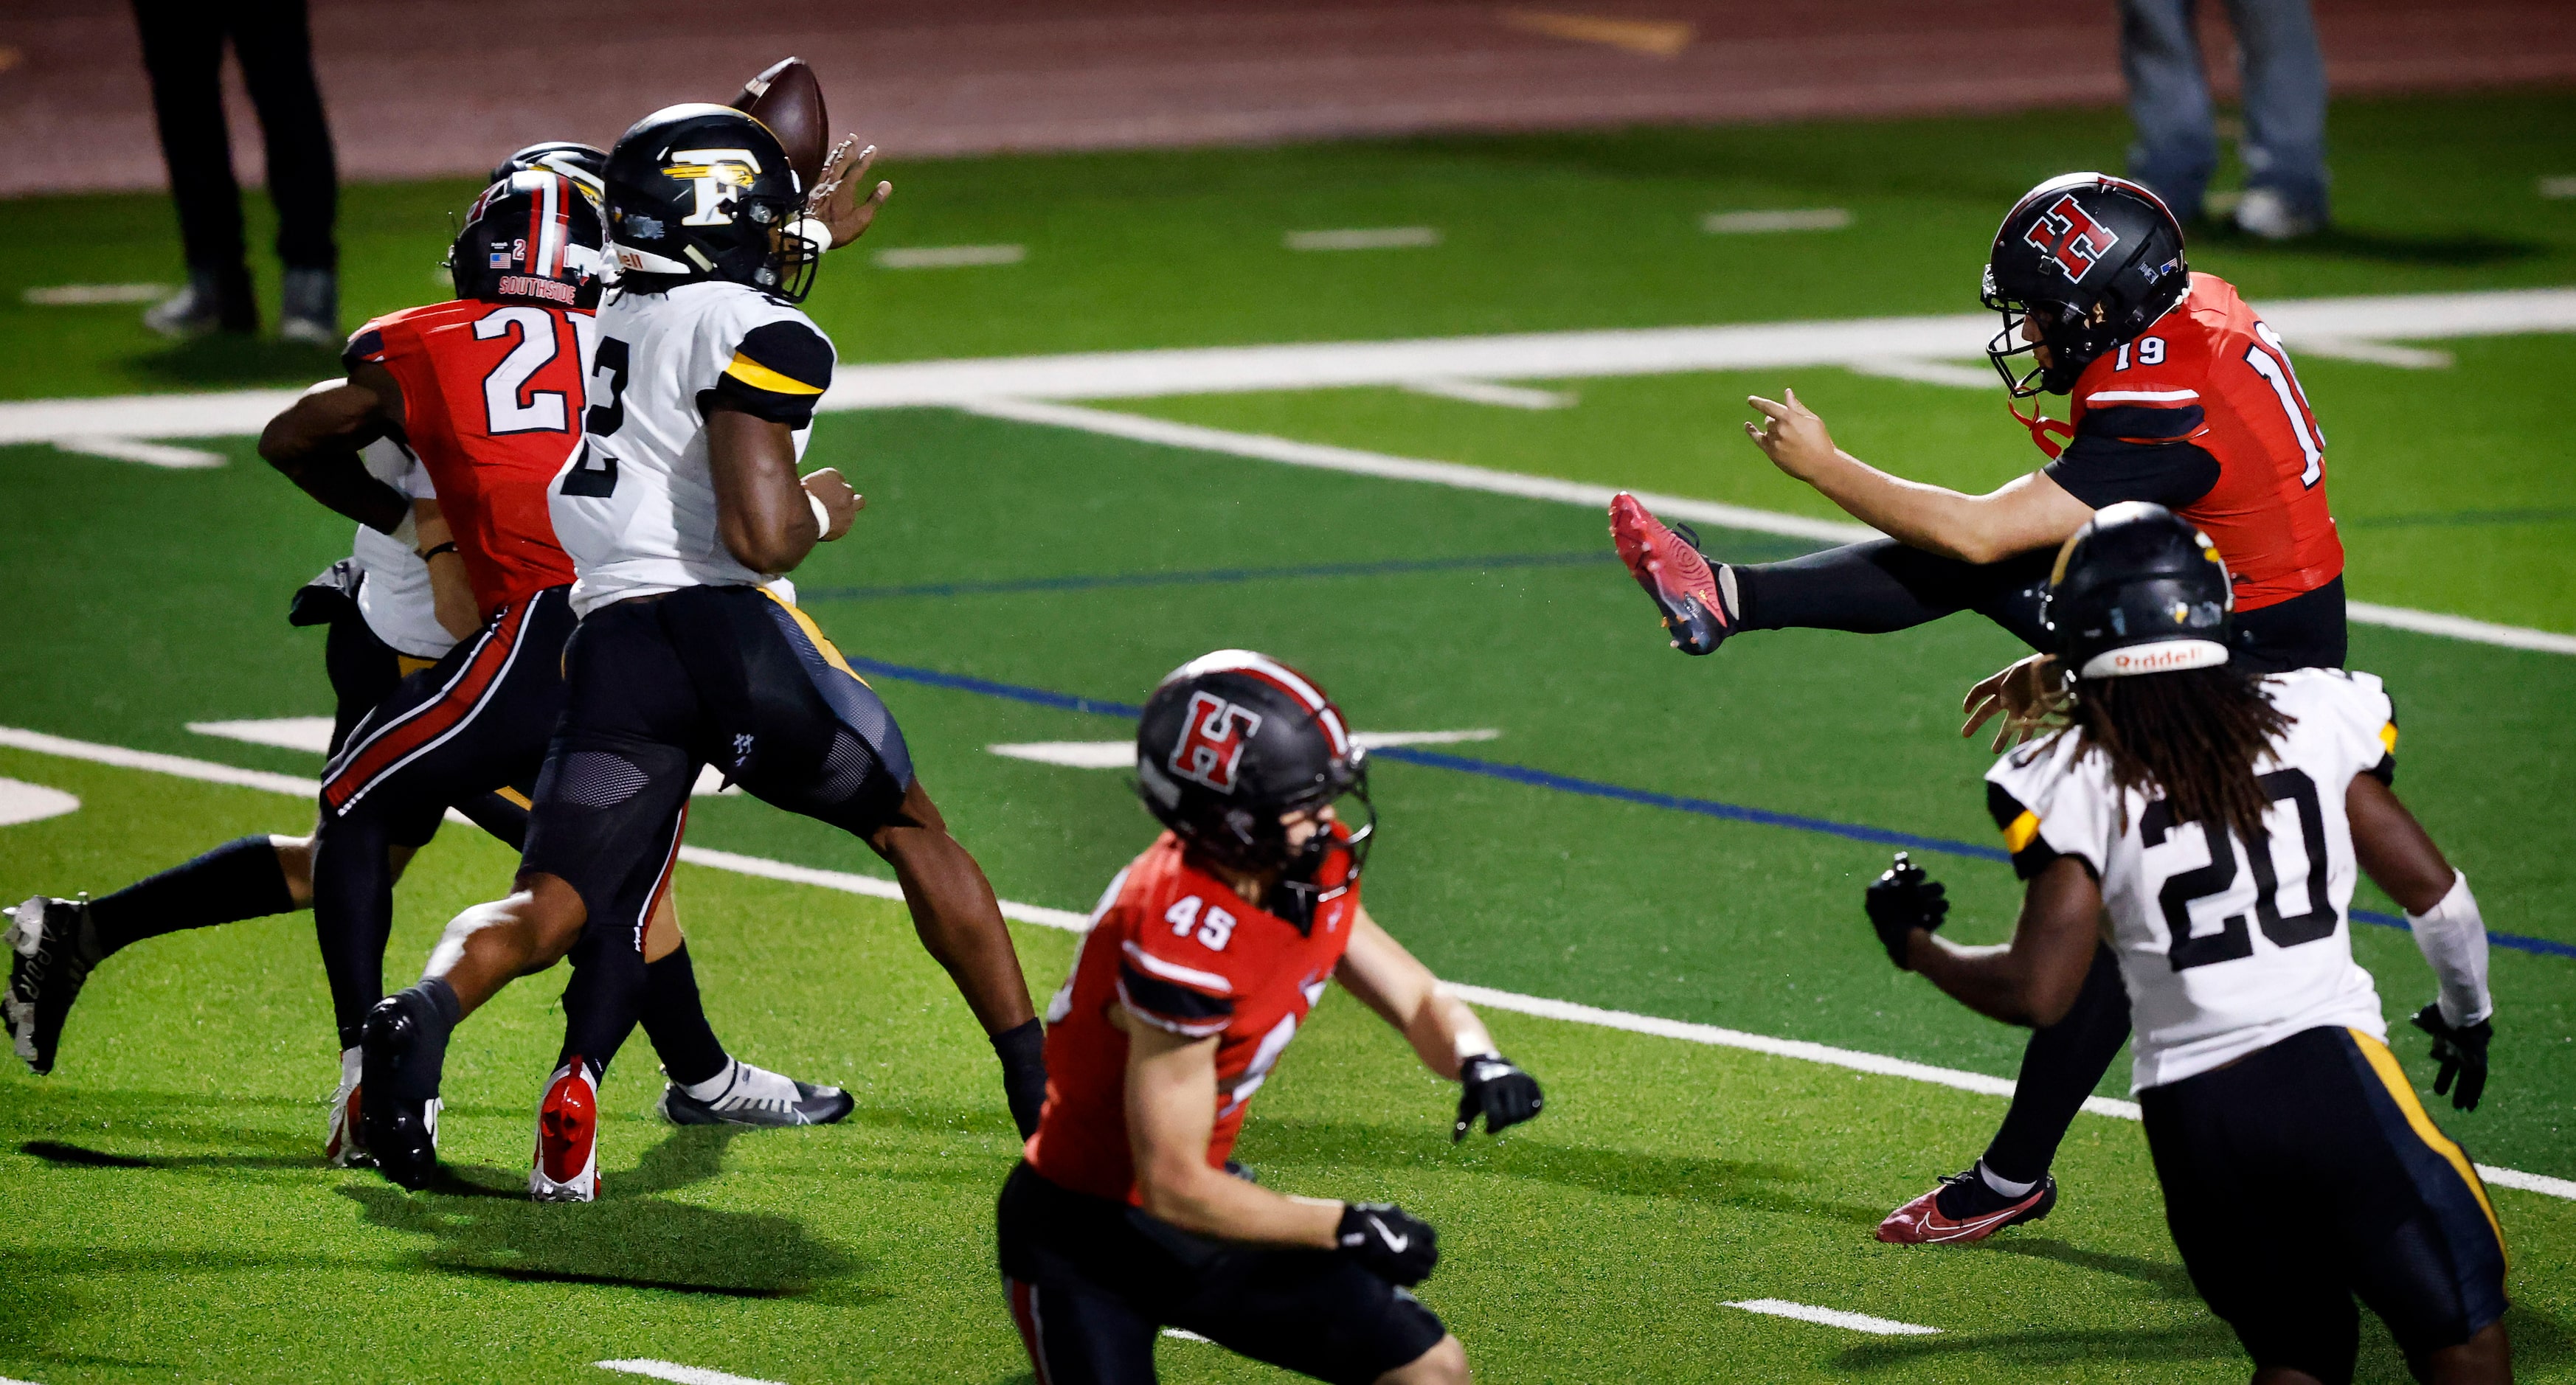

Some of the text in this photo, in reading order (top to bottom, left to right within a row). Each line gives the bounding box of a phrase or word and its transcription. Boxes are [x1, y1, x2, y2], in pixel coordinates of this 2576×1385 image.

[670, 148, 762, 226] F
[512, 238, 527, 261] 2
[2023, 193, 2119, 284] H
[499, 276, 576, 305] SOUTHSIDE
[2114, 336, 2167, 372] 19
[560, 336, 629, 498] 2
[2243, 320, 2327, 491] 1
[1168, 690, 1262, 794] H
[2139, 767, 2338, 973] 20
[1164, 895, 1237, 951] 45
